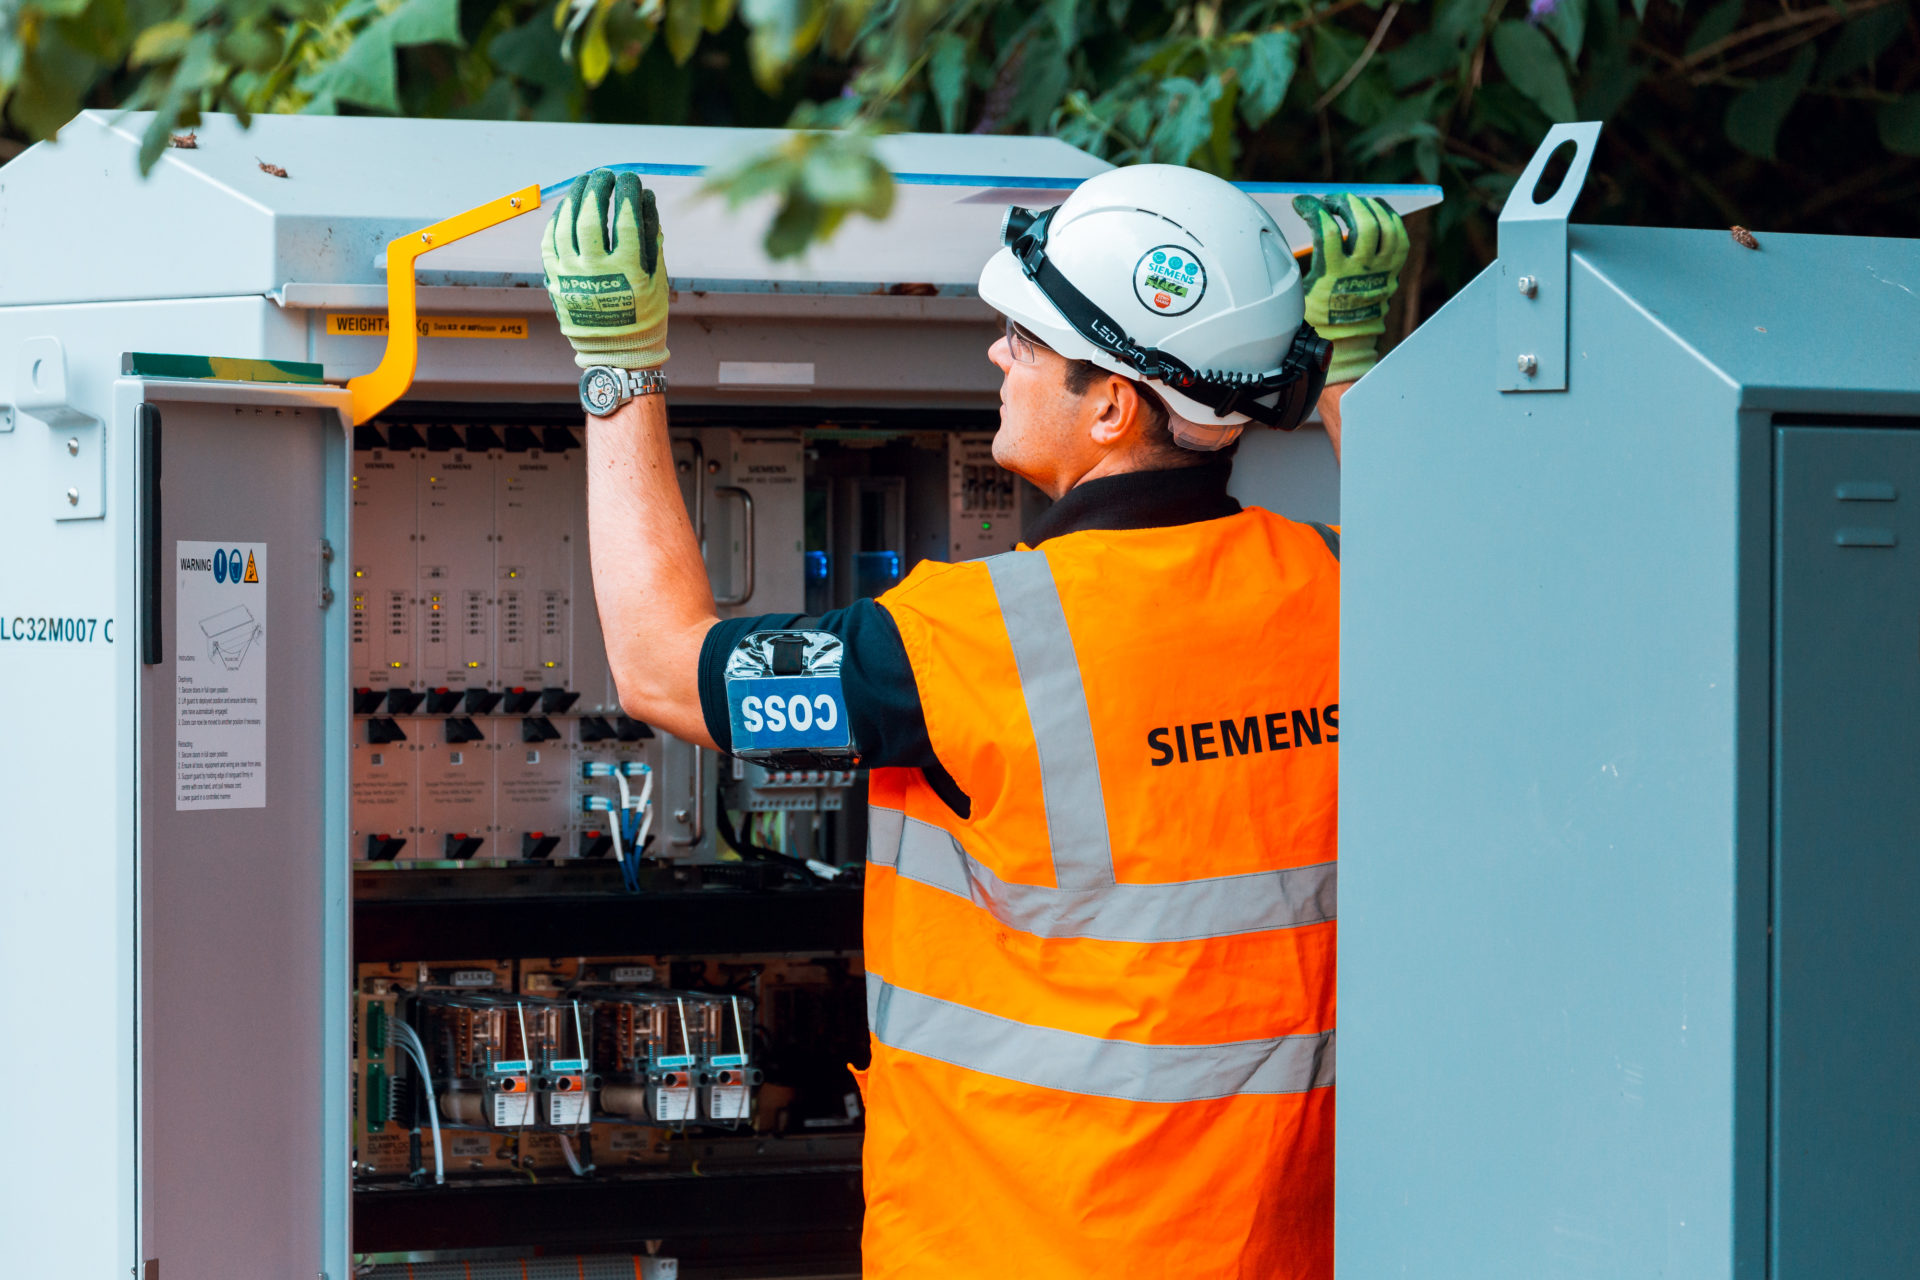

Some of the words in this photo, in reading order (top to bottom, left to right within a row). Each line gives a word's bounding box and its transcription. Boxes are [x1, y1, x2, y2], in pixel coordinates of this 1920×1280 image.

[570, 279, 621, 292] Polyco
[1148, 262, 1195, 285] SIEMENS
[336, 317, 384, 332] WEIGHT
[1091, 319, 1118, 344] LED
[180, 558, 212, 572] WARNING
[0, 616, 97, 643] LC32M007
[742, 694, 838, 732] COSS
[1147, 703, 1339, 767] SIEMENS
